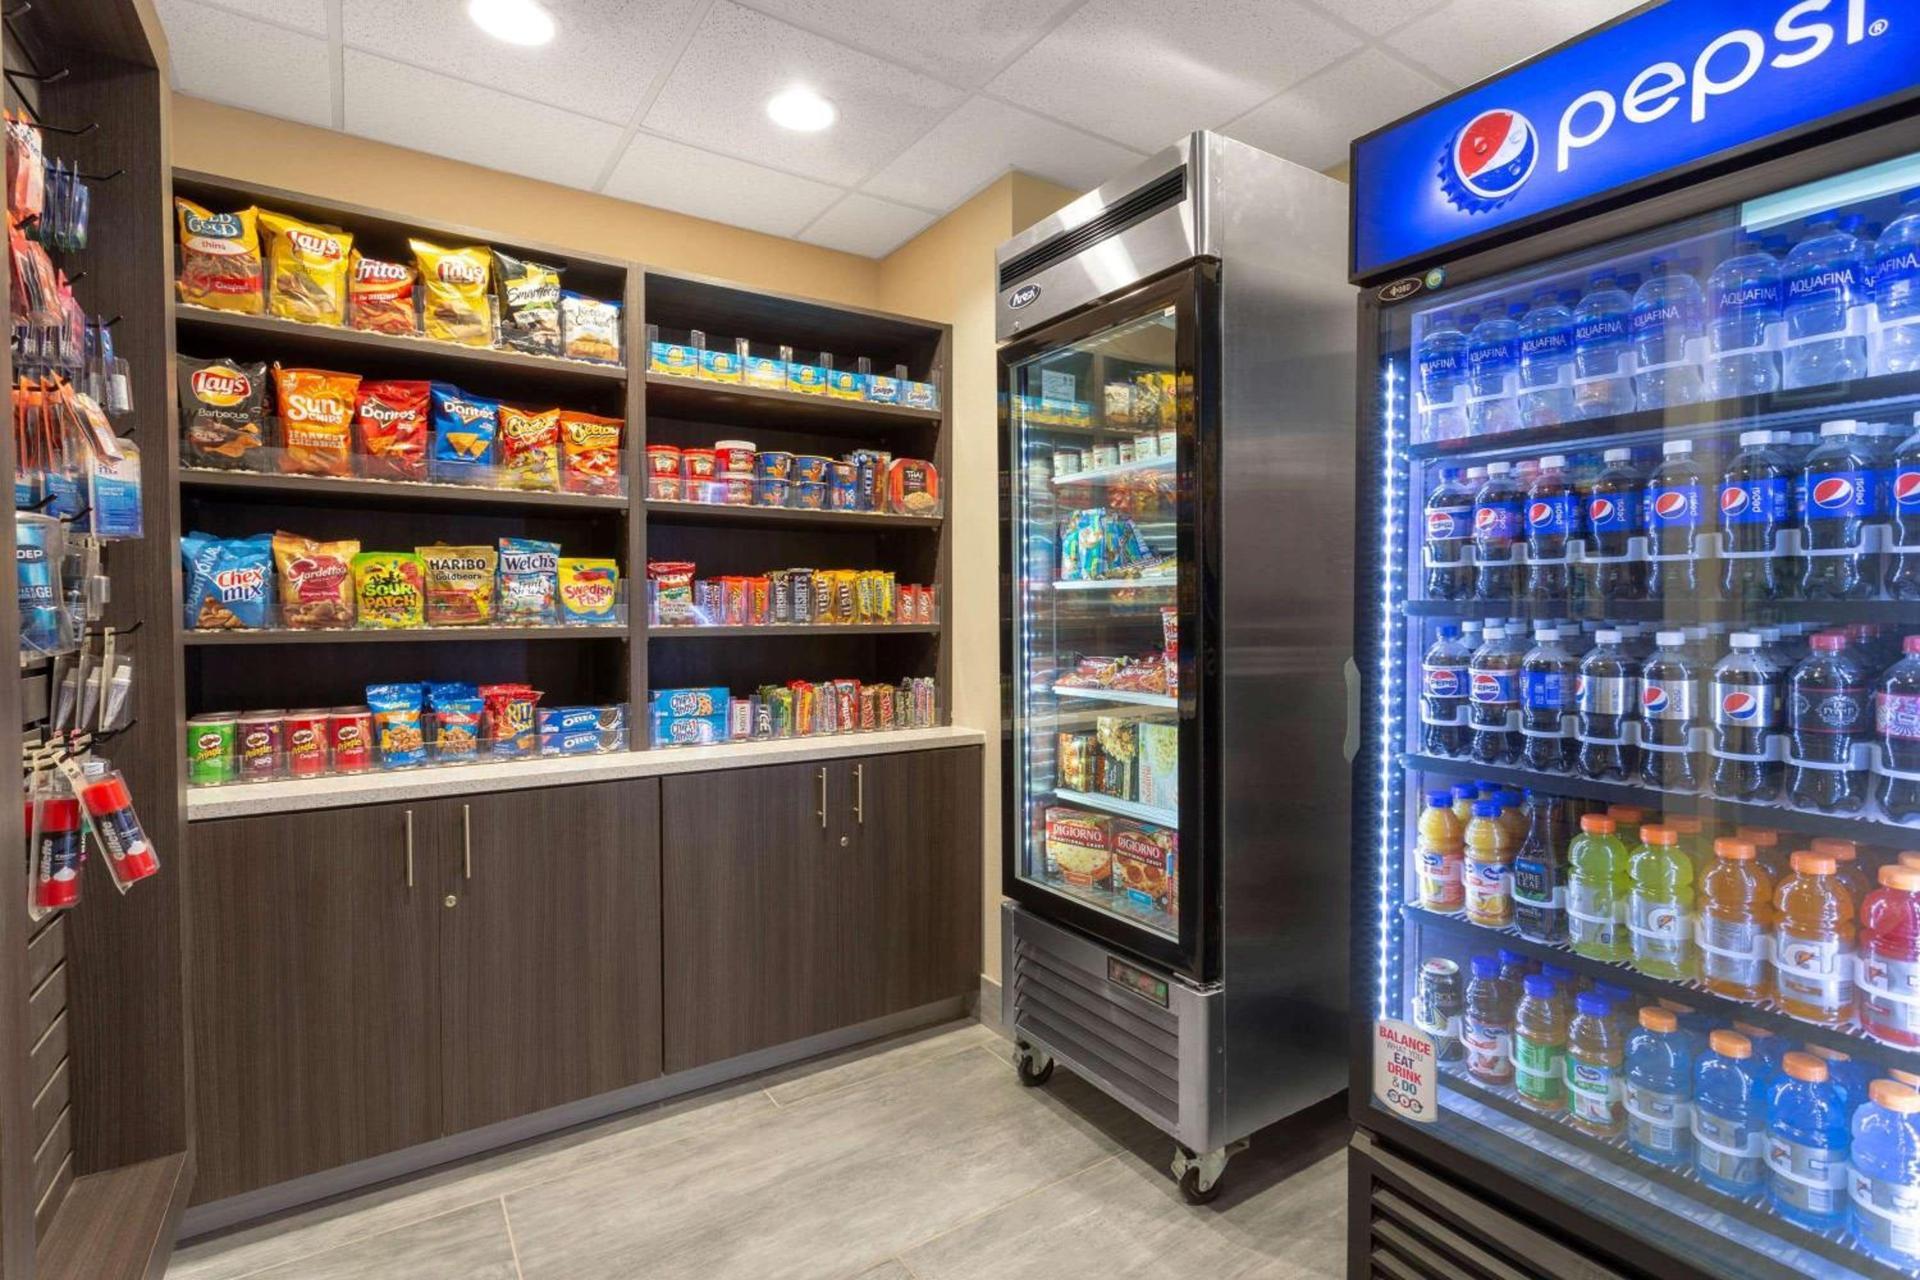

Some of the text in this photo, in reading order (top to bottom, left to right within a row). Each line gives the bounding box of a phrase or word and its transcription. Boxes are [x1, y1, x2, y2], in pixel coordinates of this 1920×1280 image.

[1557, 0, 1866, 173] pepsi
[1790, 269, 1856, 297] AQUAFINA
[1719, 286, 1777, 308] AQUAFINA
[197, 373, 245, 394] Lay's
[198, 407, 249, 420] Barbecue
[287, 394, 344, 421] Sun
[1751, 487, 1761, 513] pepsi
[1855, 477, 1865, 505] pepsi
[16, 549, 43, 560] DEP
[505, 555, 556, 570] Welch's
[217, 570, 263, 588] Chex
[366, 582, 413, 597] SOUR
[364, 594, 416, 608] PATCH
[564, 584, 613, 600] Swedish
[102, 821, 126, 861] Gillette
[1053, 823, 1102, 841] DIGIORNO
[1119, 836, 1160, 858] DIGIORNO
[40, 839, 53, 883] Gillette
[1379, 1024, 1431, 1056] BALANCE
[1394, 1052, 1415, 1069] EAT
[1387, 1061, 1423, 1087] DRINK
[1401, 1080, 1417, 1096] DO
